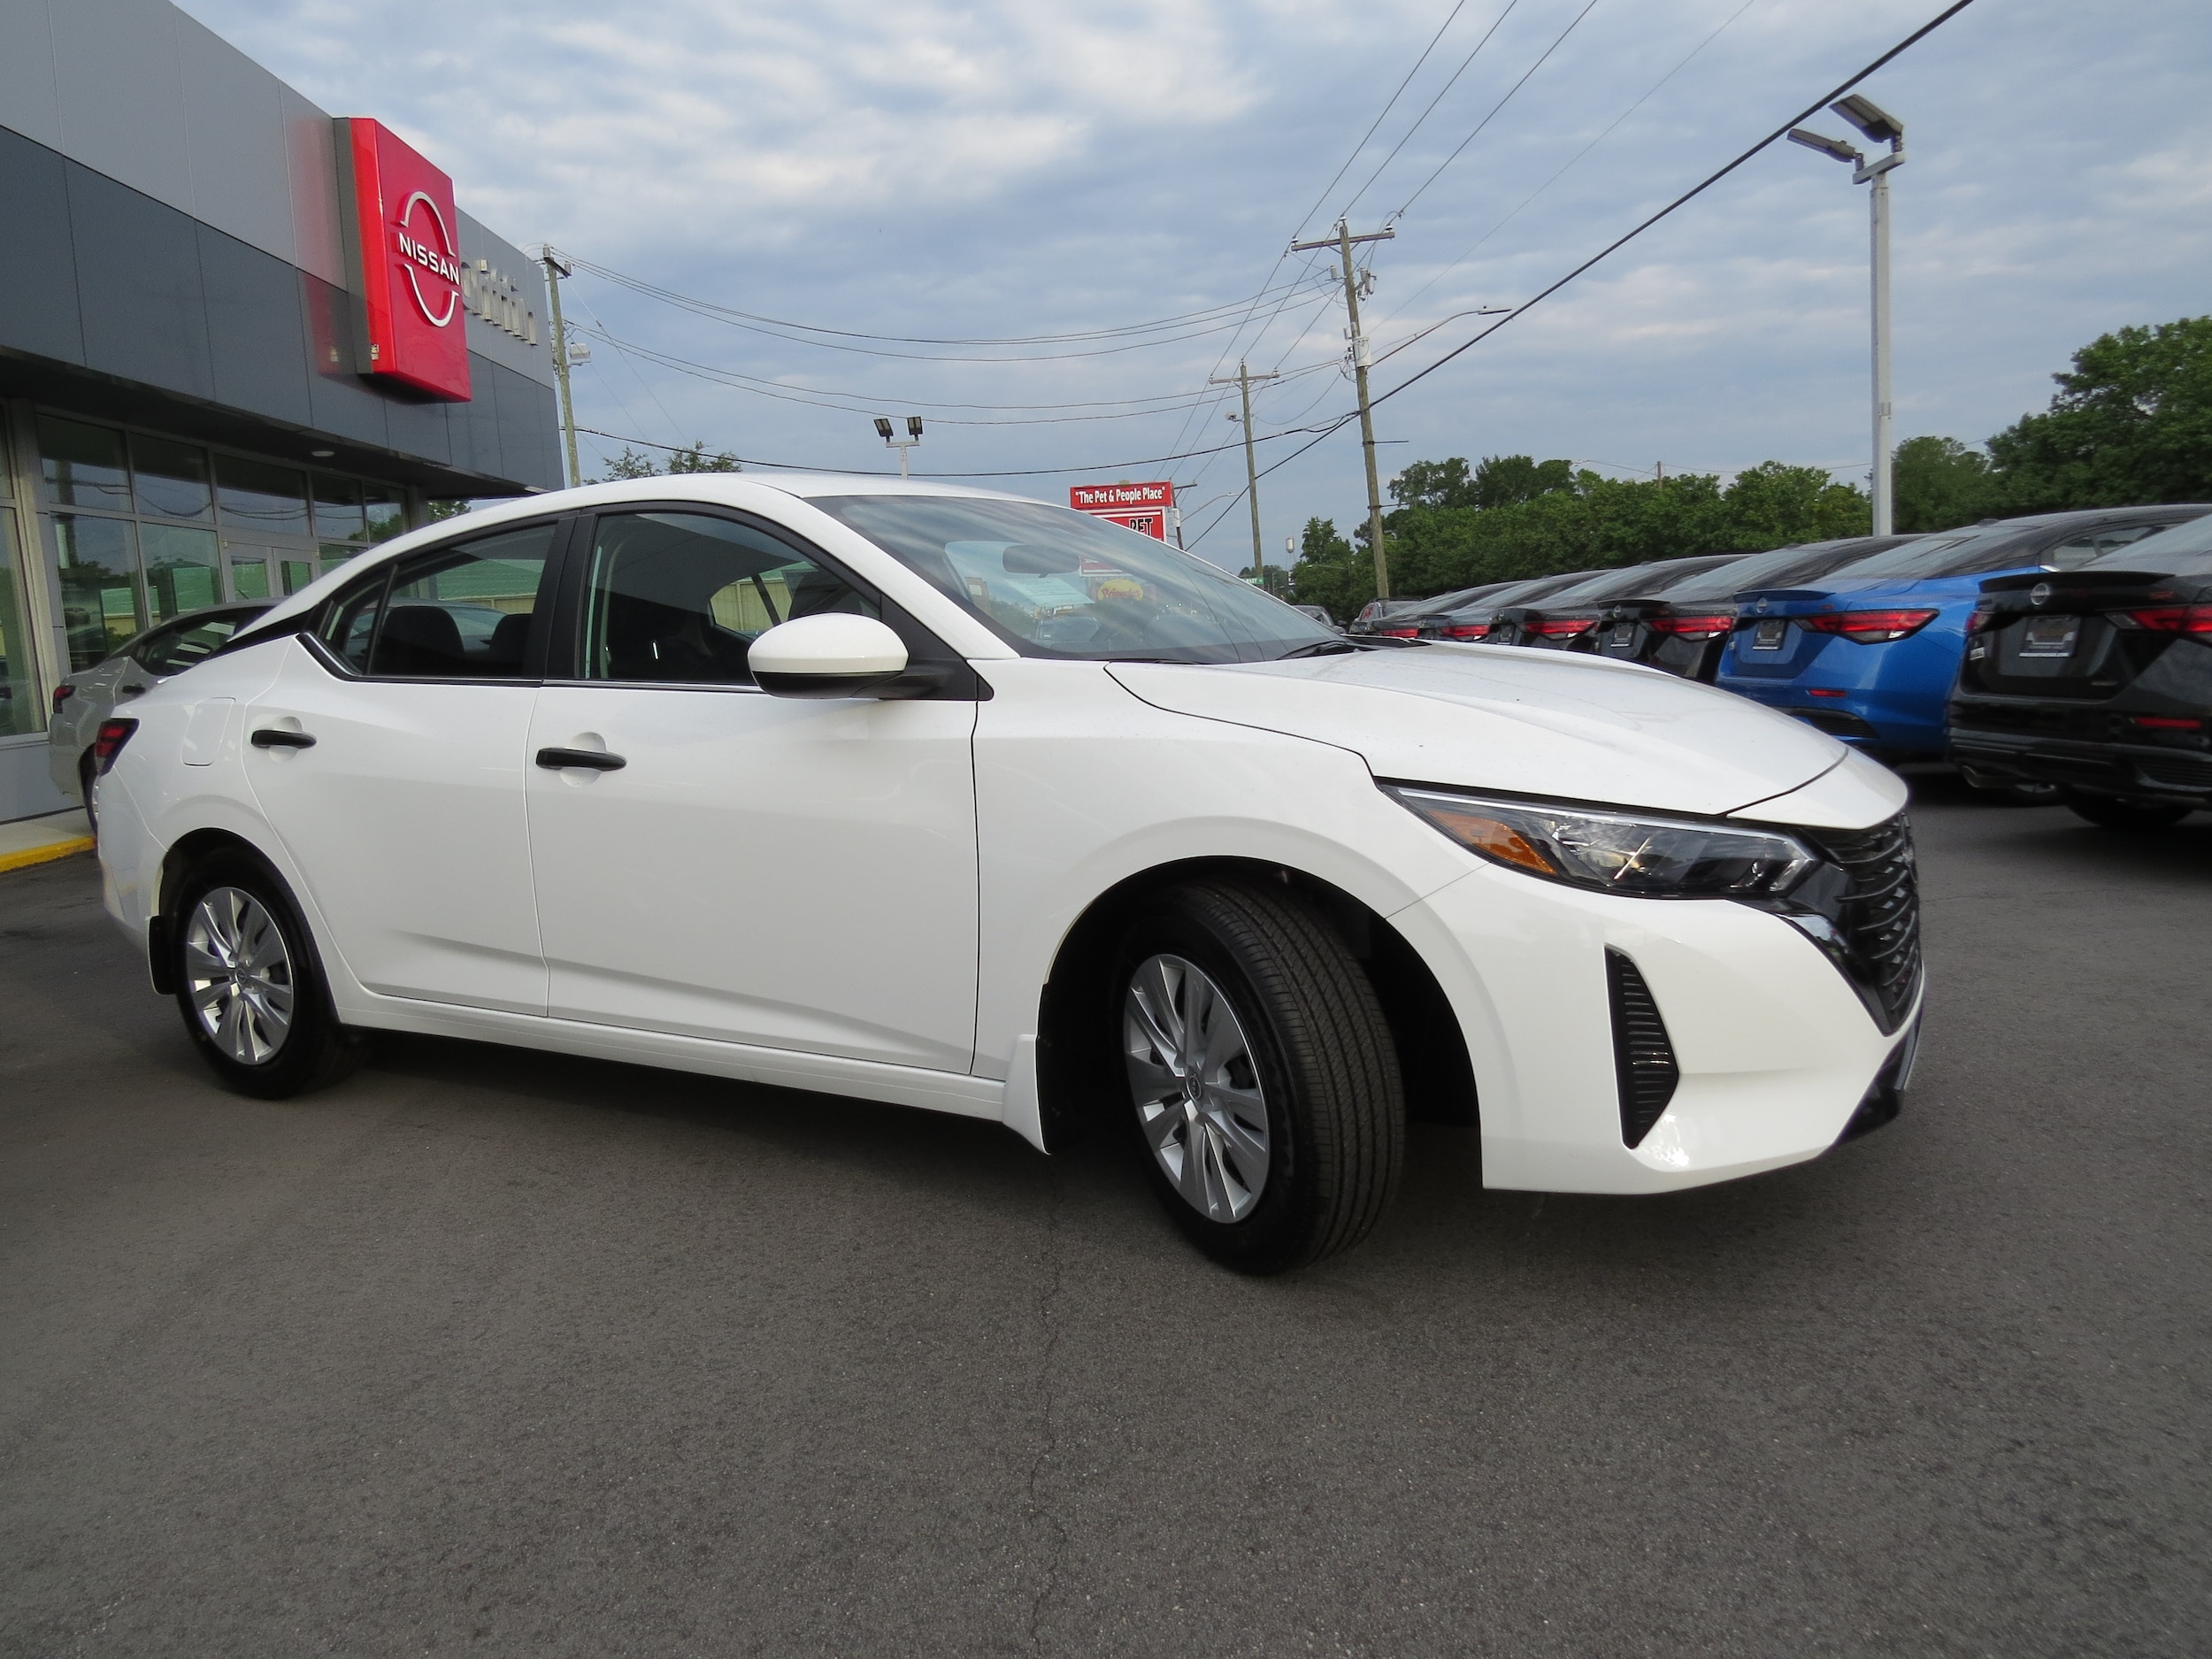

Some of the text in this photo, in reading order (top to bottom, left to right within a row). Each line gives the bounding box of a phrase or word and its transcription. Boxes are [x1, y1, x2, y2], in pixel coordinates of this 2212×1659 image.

[398, 232, 460, 286] NISSAN
[1094, 490, 1108, 503] Pet
[1108, 489, 1115, 503] &
[1116, 488, 1141, 504] People
